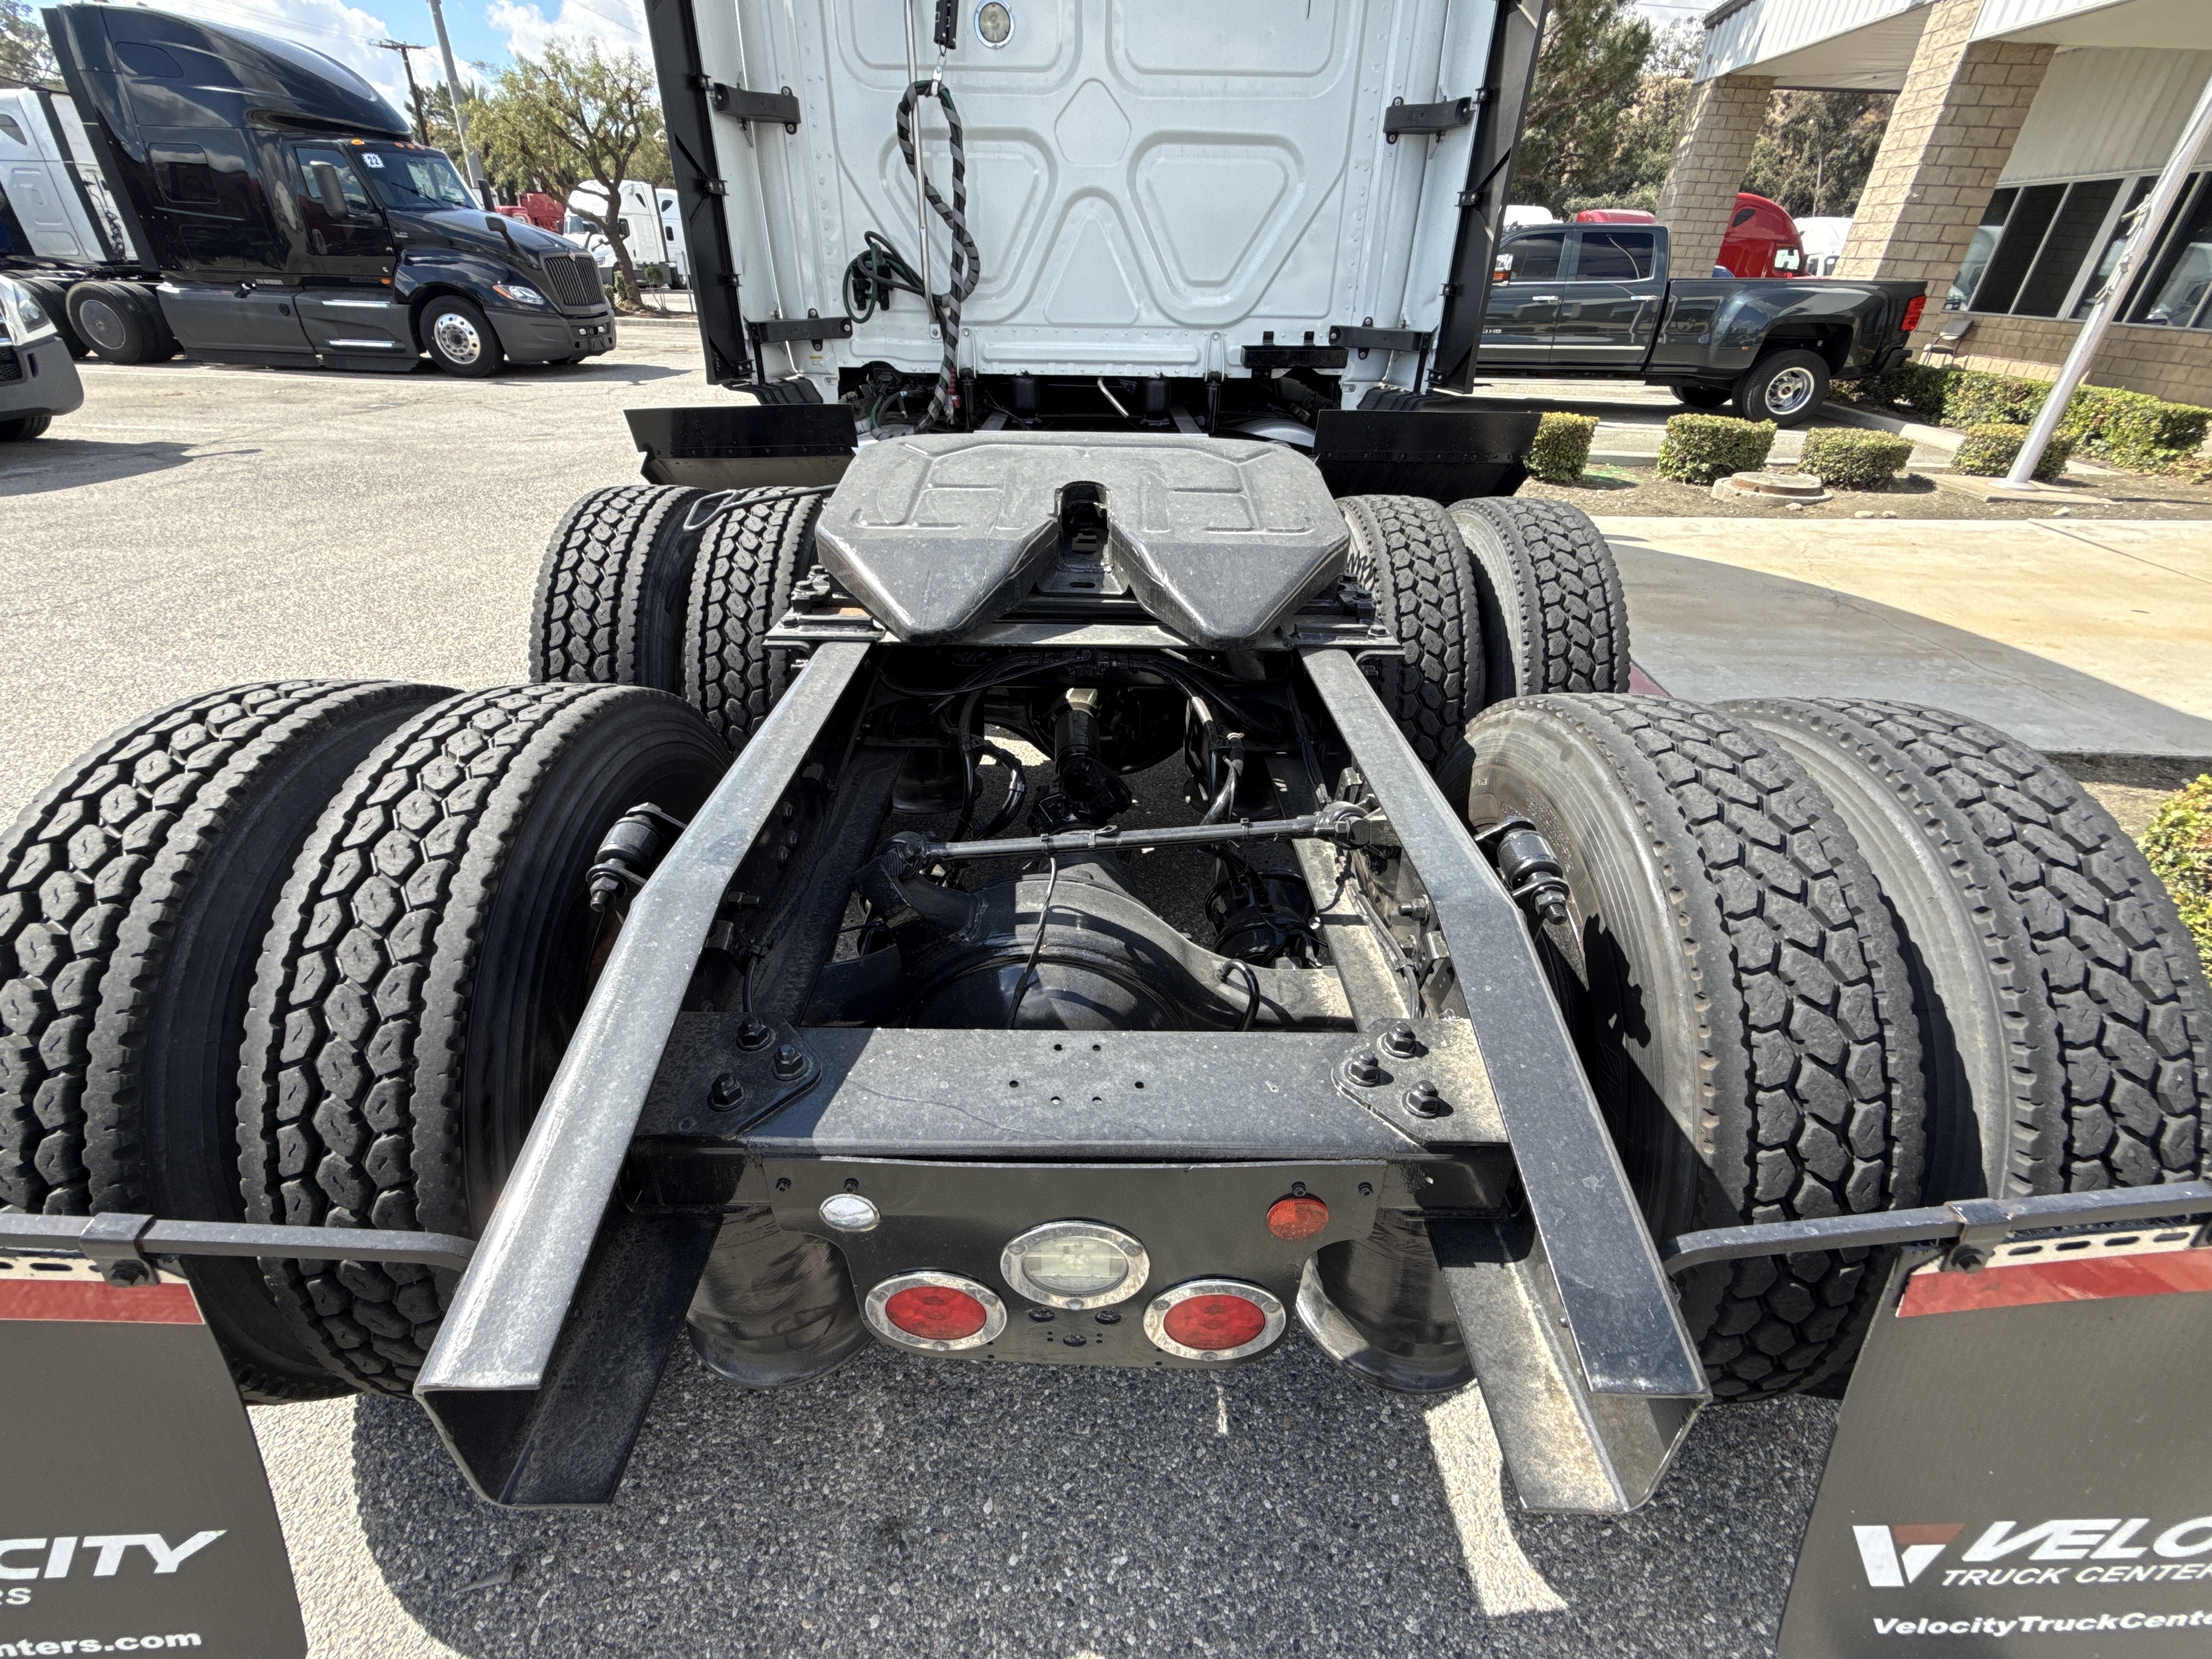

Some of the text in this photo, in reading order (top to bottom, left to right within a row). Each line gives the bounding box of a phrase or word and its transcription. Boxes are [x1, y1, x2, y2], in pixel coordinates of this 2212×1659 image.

[367, 156, 380, 165] 22
[0, 1530, 228, 1579] CITY
[1961, 1515, 2212, 1562] VELO
[1942, 1567, 2071, 1586] TRUCK
